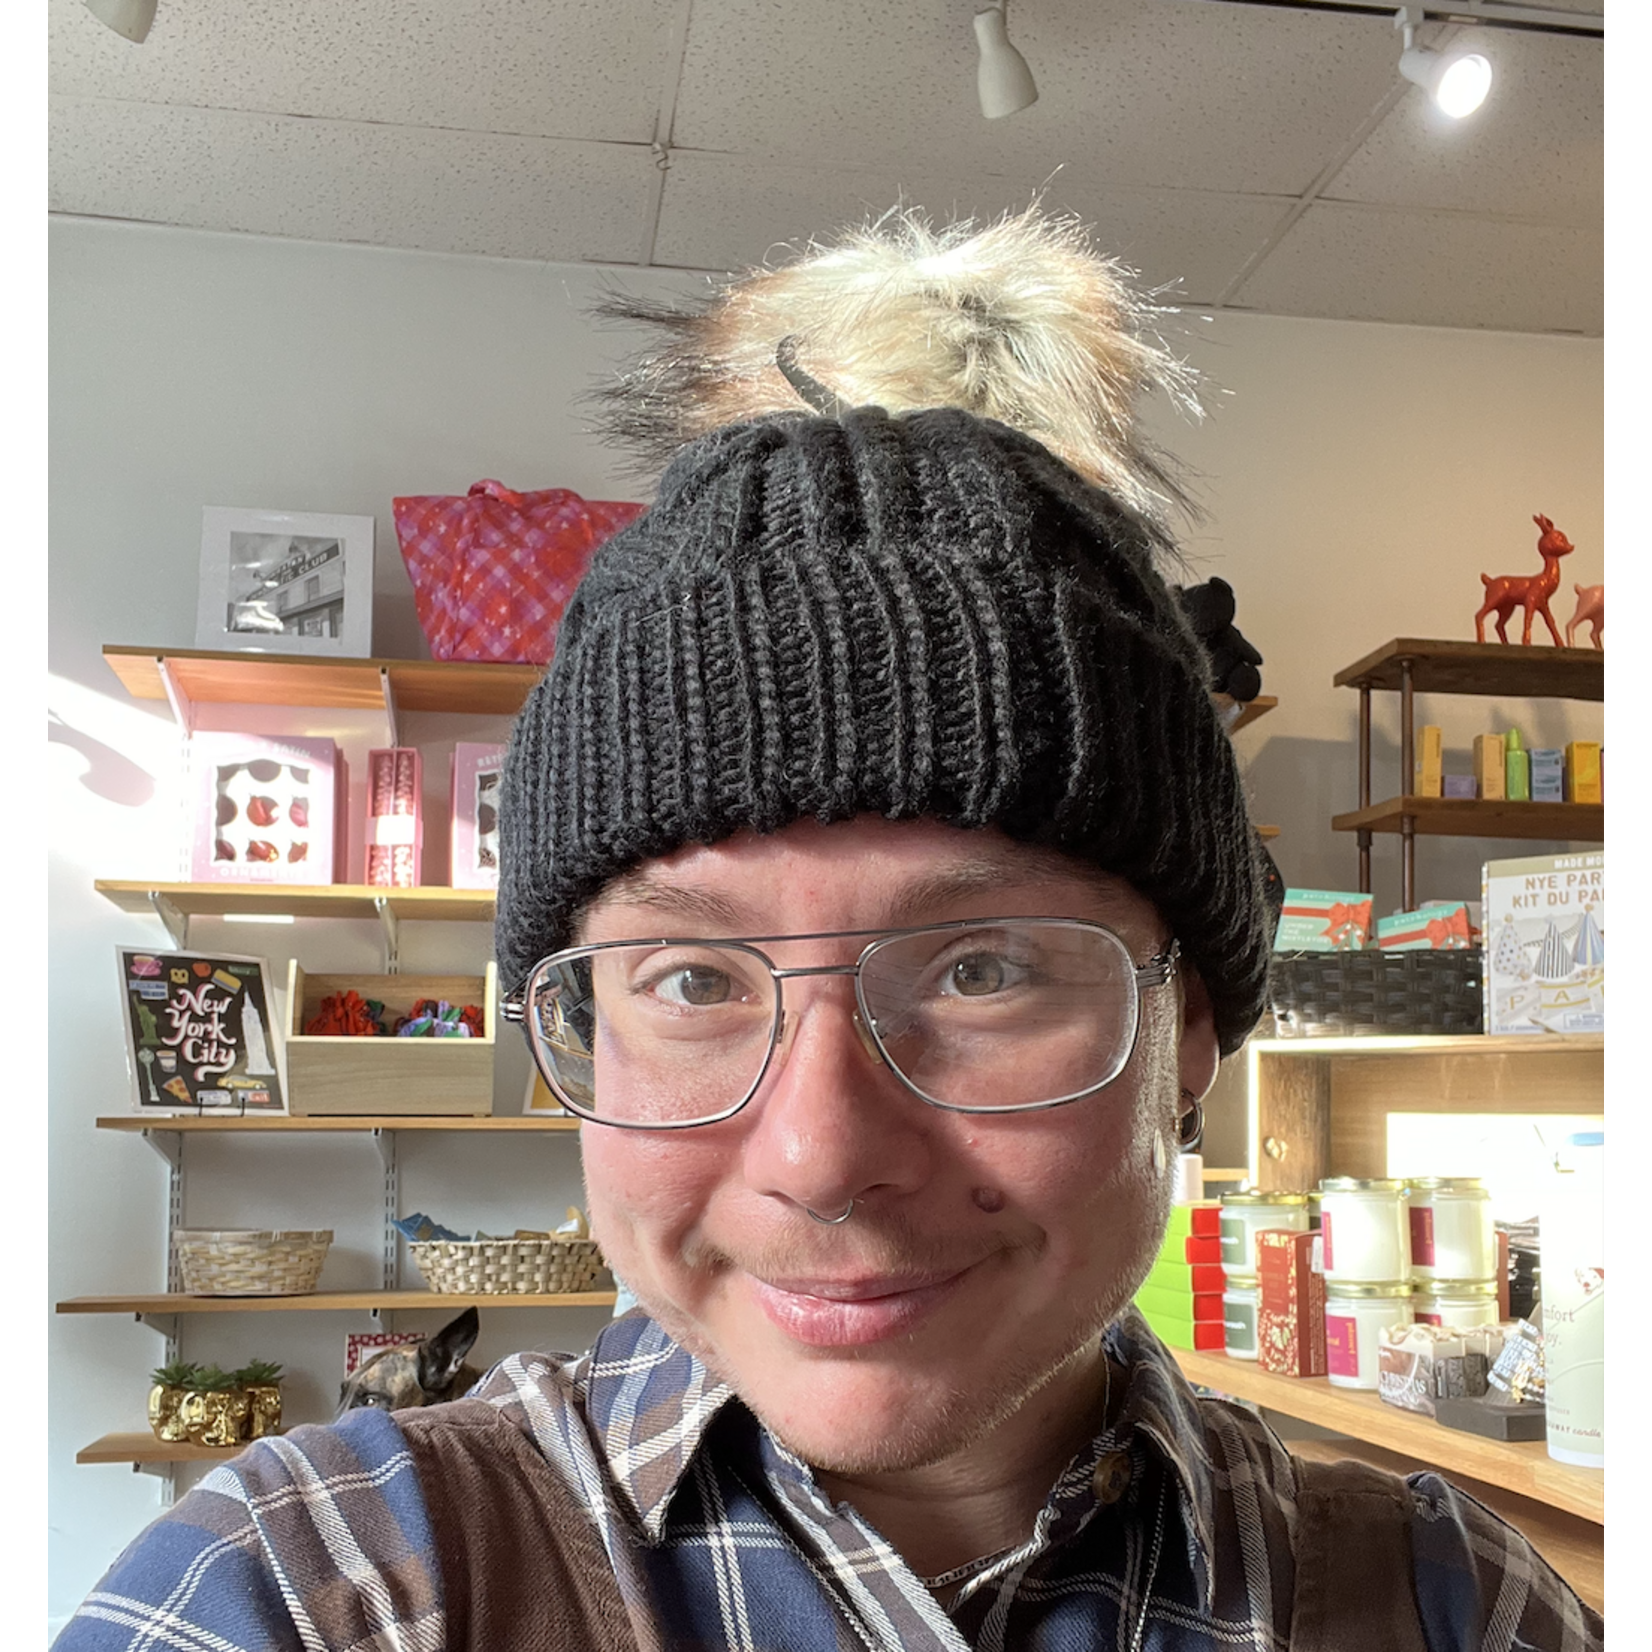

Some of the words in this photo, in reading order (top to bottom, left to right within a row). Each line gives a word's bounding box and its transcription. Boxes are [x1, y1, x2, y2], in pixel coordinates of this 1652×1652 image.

[1554, 857, 1583, 869] MADE
[1525, 875, 1558, 891] NYE
[1566, 871, 1602, 887] PAR
[1512, 893, 1540, 909] KIT
[1547, 891, 1569, 906] DU
[1578, 888, 1601, 903] PA
[170, 983, 233, 1017] New
[1509, 995, 1525, 1010] P
[161, 1007, 237, 1046] York
[182, 1037, 237, 1082] City
